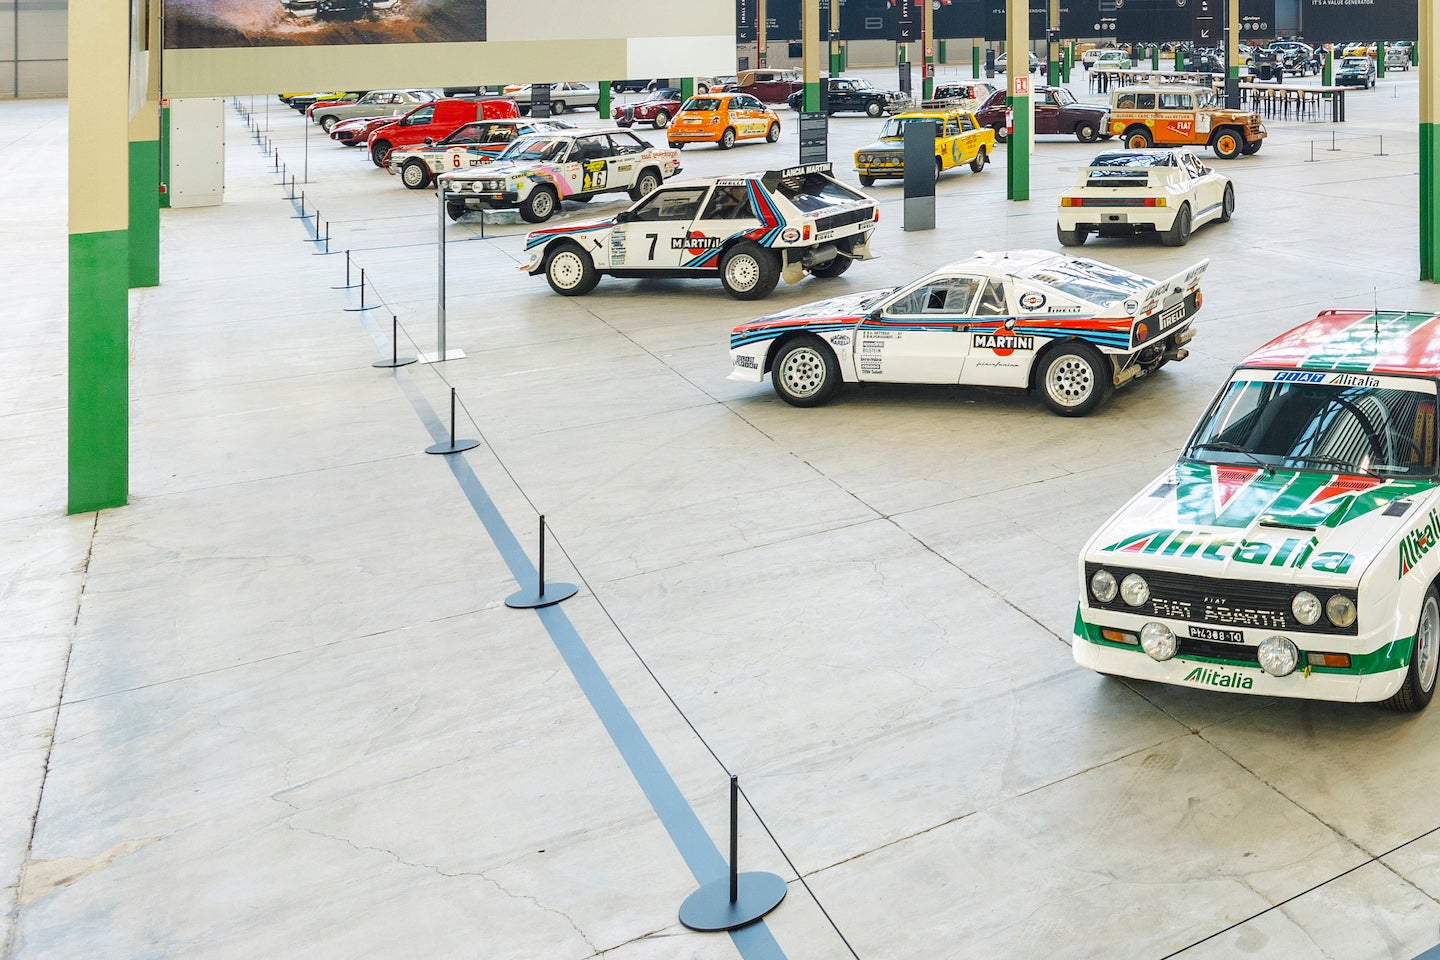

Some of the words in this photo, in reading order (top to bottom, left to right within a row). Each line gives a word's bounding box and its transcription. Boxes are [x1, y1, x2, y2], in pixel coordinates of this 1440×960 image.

[453, 154, 460, 168] 6
[596, 172, 602, 185] 6
[782, 167, 805, 178] LANCIA
[806, 163, 832, 175] MARTINI
[646, 234, 658, 260] 7
[672, 238, 720, 249] MARTINI
[1146, 282, 1170, 301] LANCIA
[1158, 302, 1186, 330] PIRELLI
[974, 336, 1034, 350] MARTINI
[1274, 372, 1326, 382] FIAT
[1329, 374, 1380, 387] Alitalia
[1101, 528, 1356, 574] Alitalia
[1152, 598, 1192, 618] FIAT
[1204, 606, 1286, 628] ABARTH
[1184, 667, 1254, 689] Alitalia
